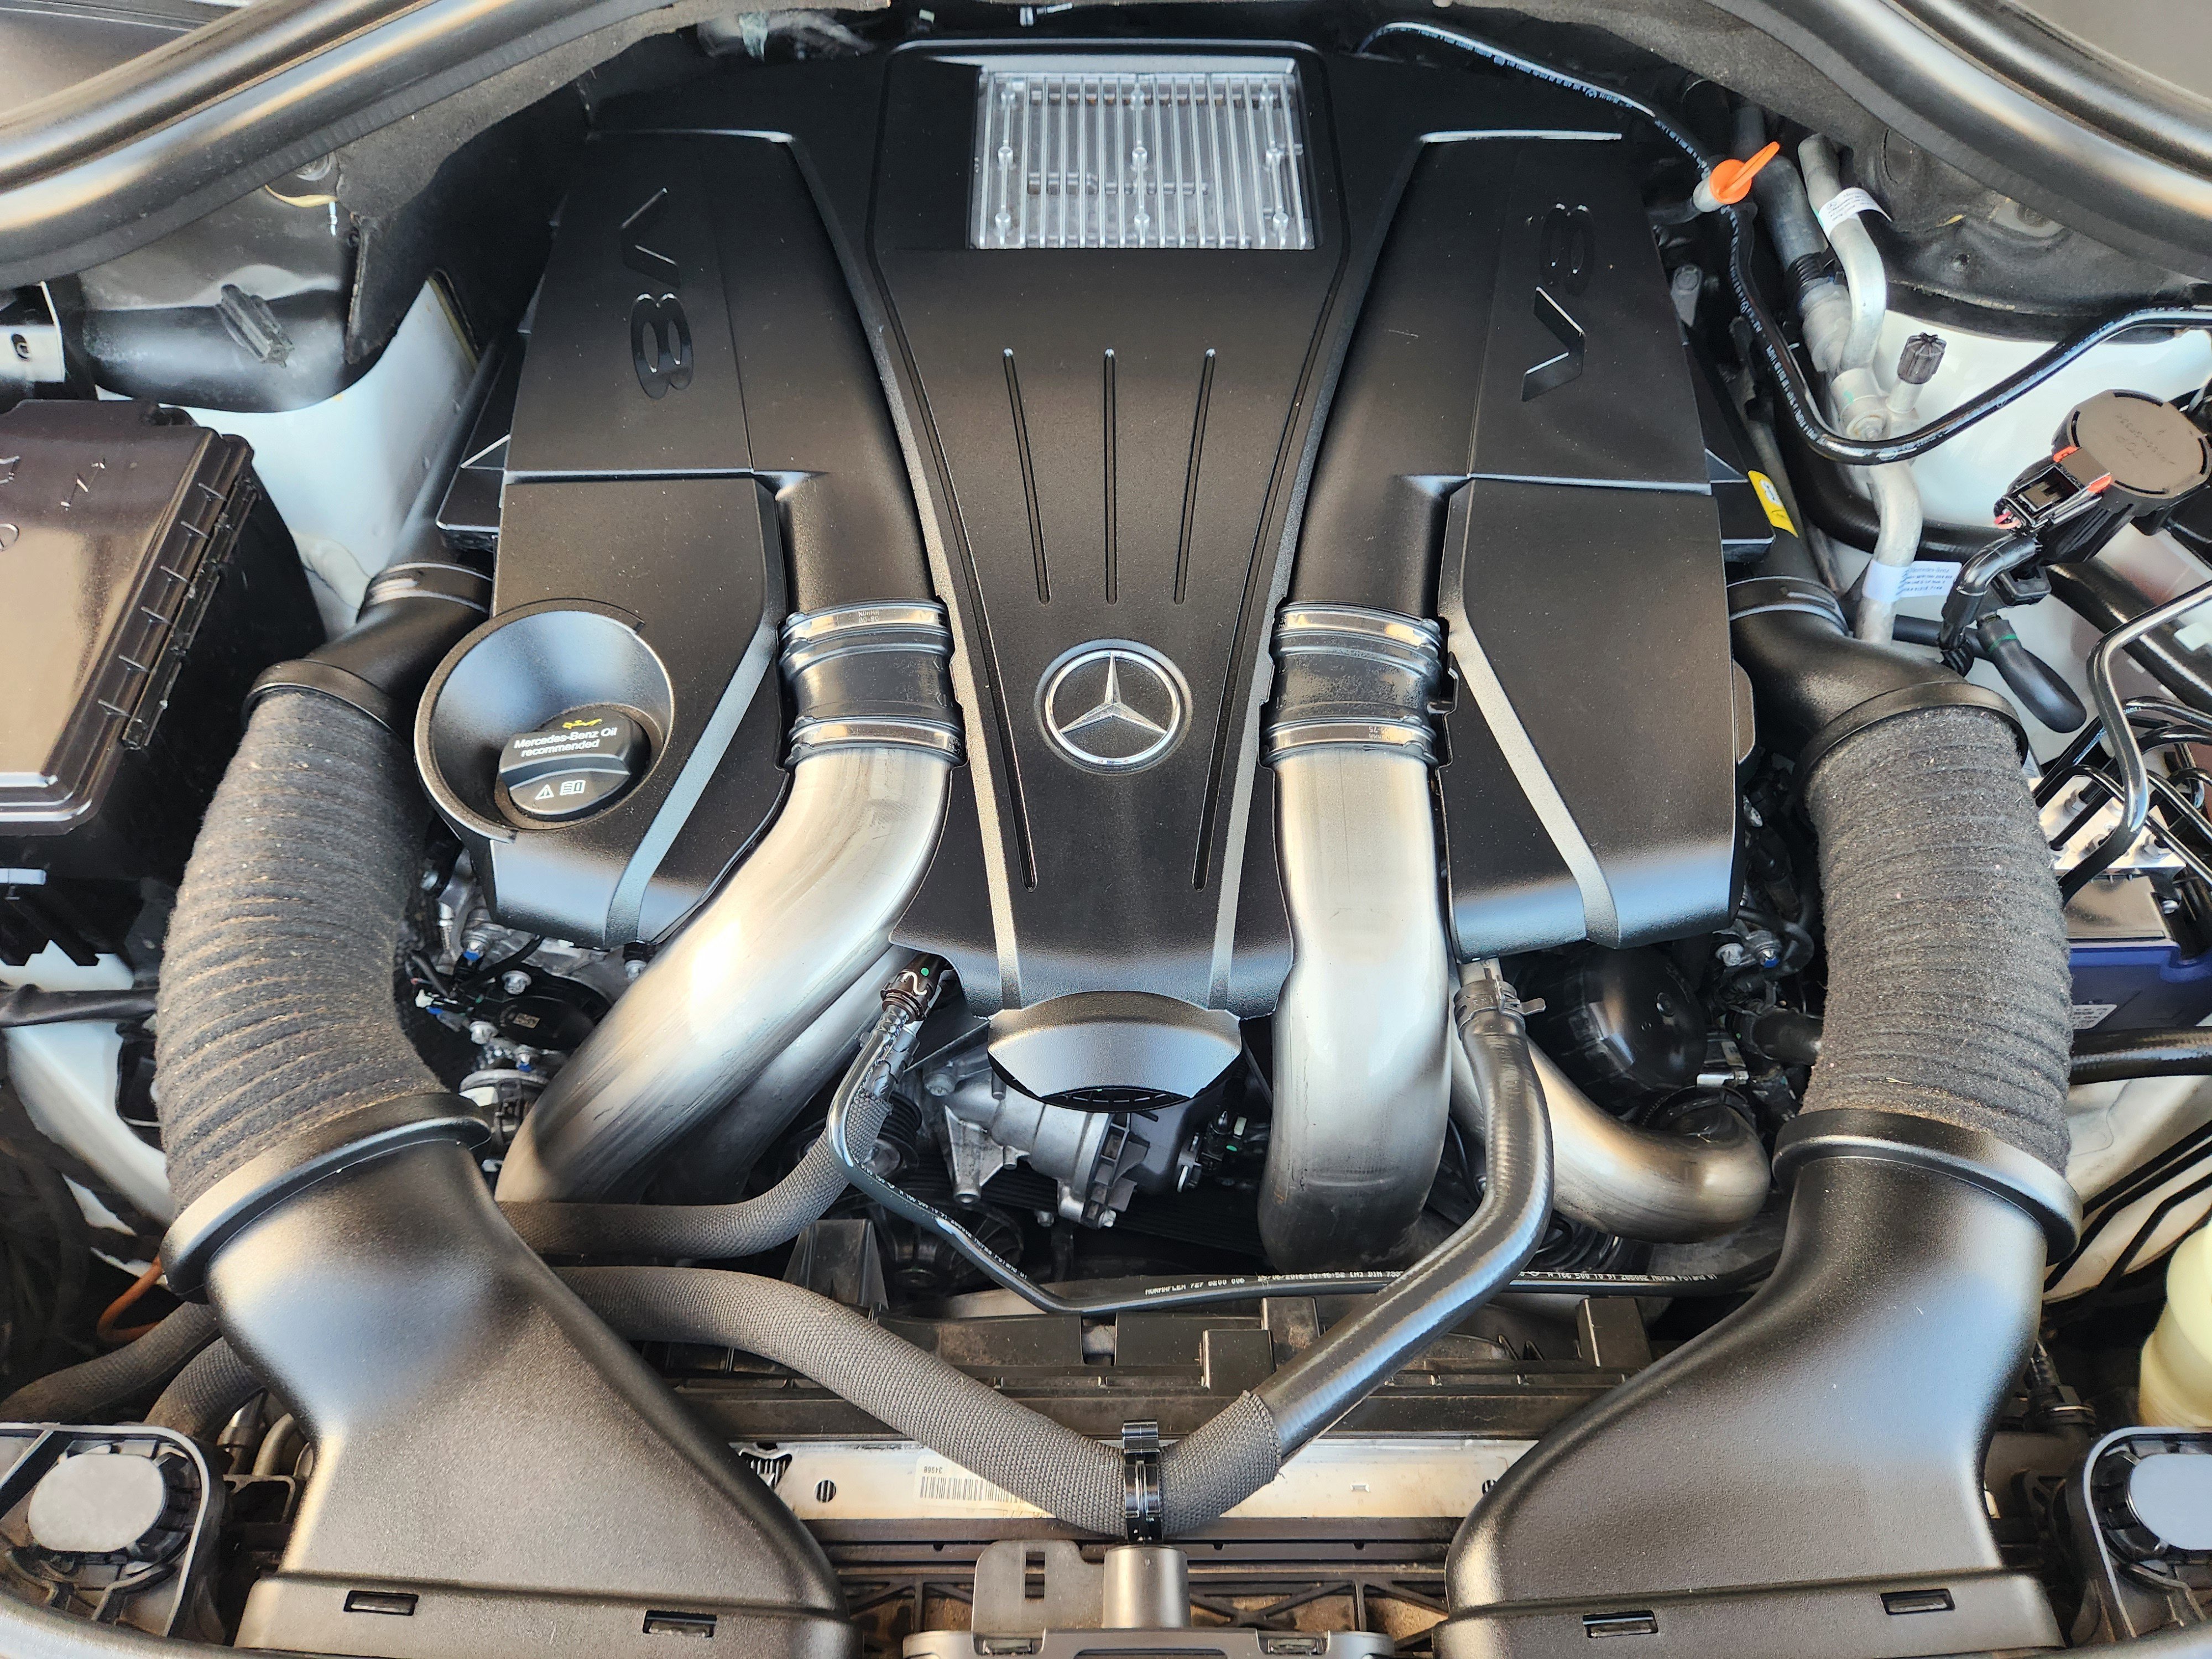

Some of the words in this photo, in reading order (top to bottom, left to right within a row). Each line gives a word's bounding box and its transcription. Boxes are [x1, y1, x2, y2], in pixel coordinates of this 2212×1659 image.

[620, 187, 693, 399] V8
[1521, 202, 1595, 401] V8
[514, 730, 599, 749] Mercedes-Benz
[601, 727, 617, 737] Oil
[521, 739, 599, 757] recommended
[948, 736, 962, 748] NORM
[994, 1254, 1018, 1274] Poland
